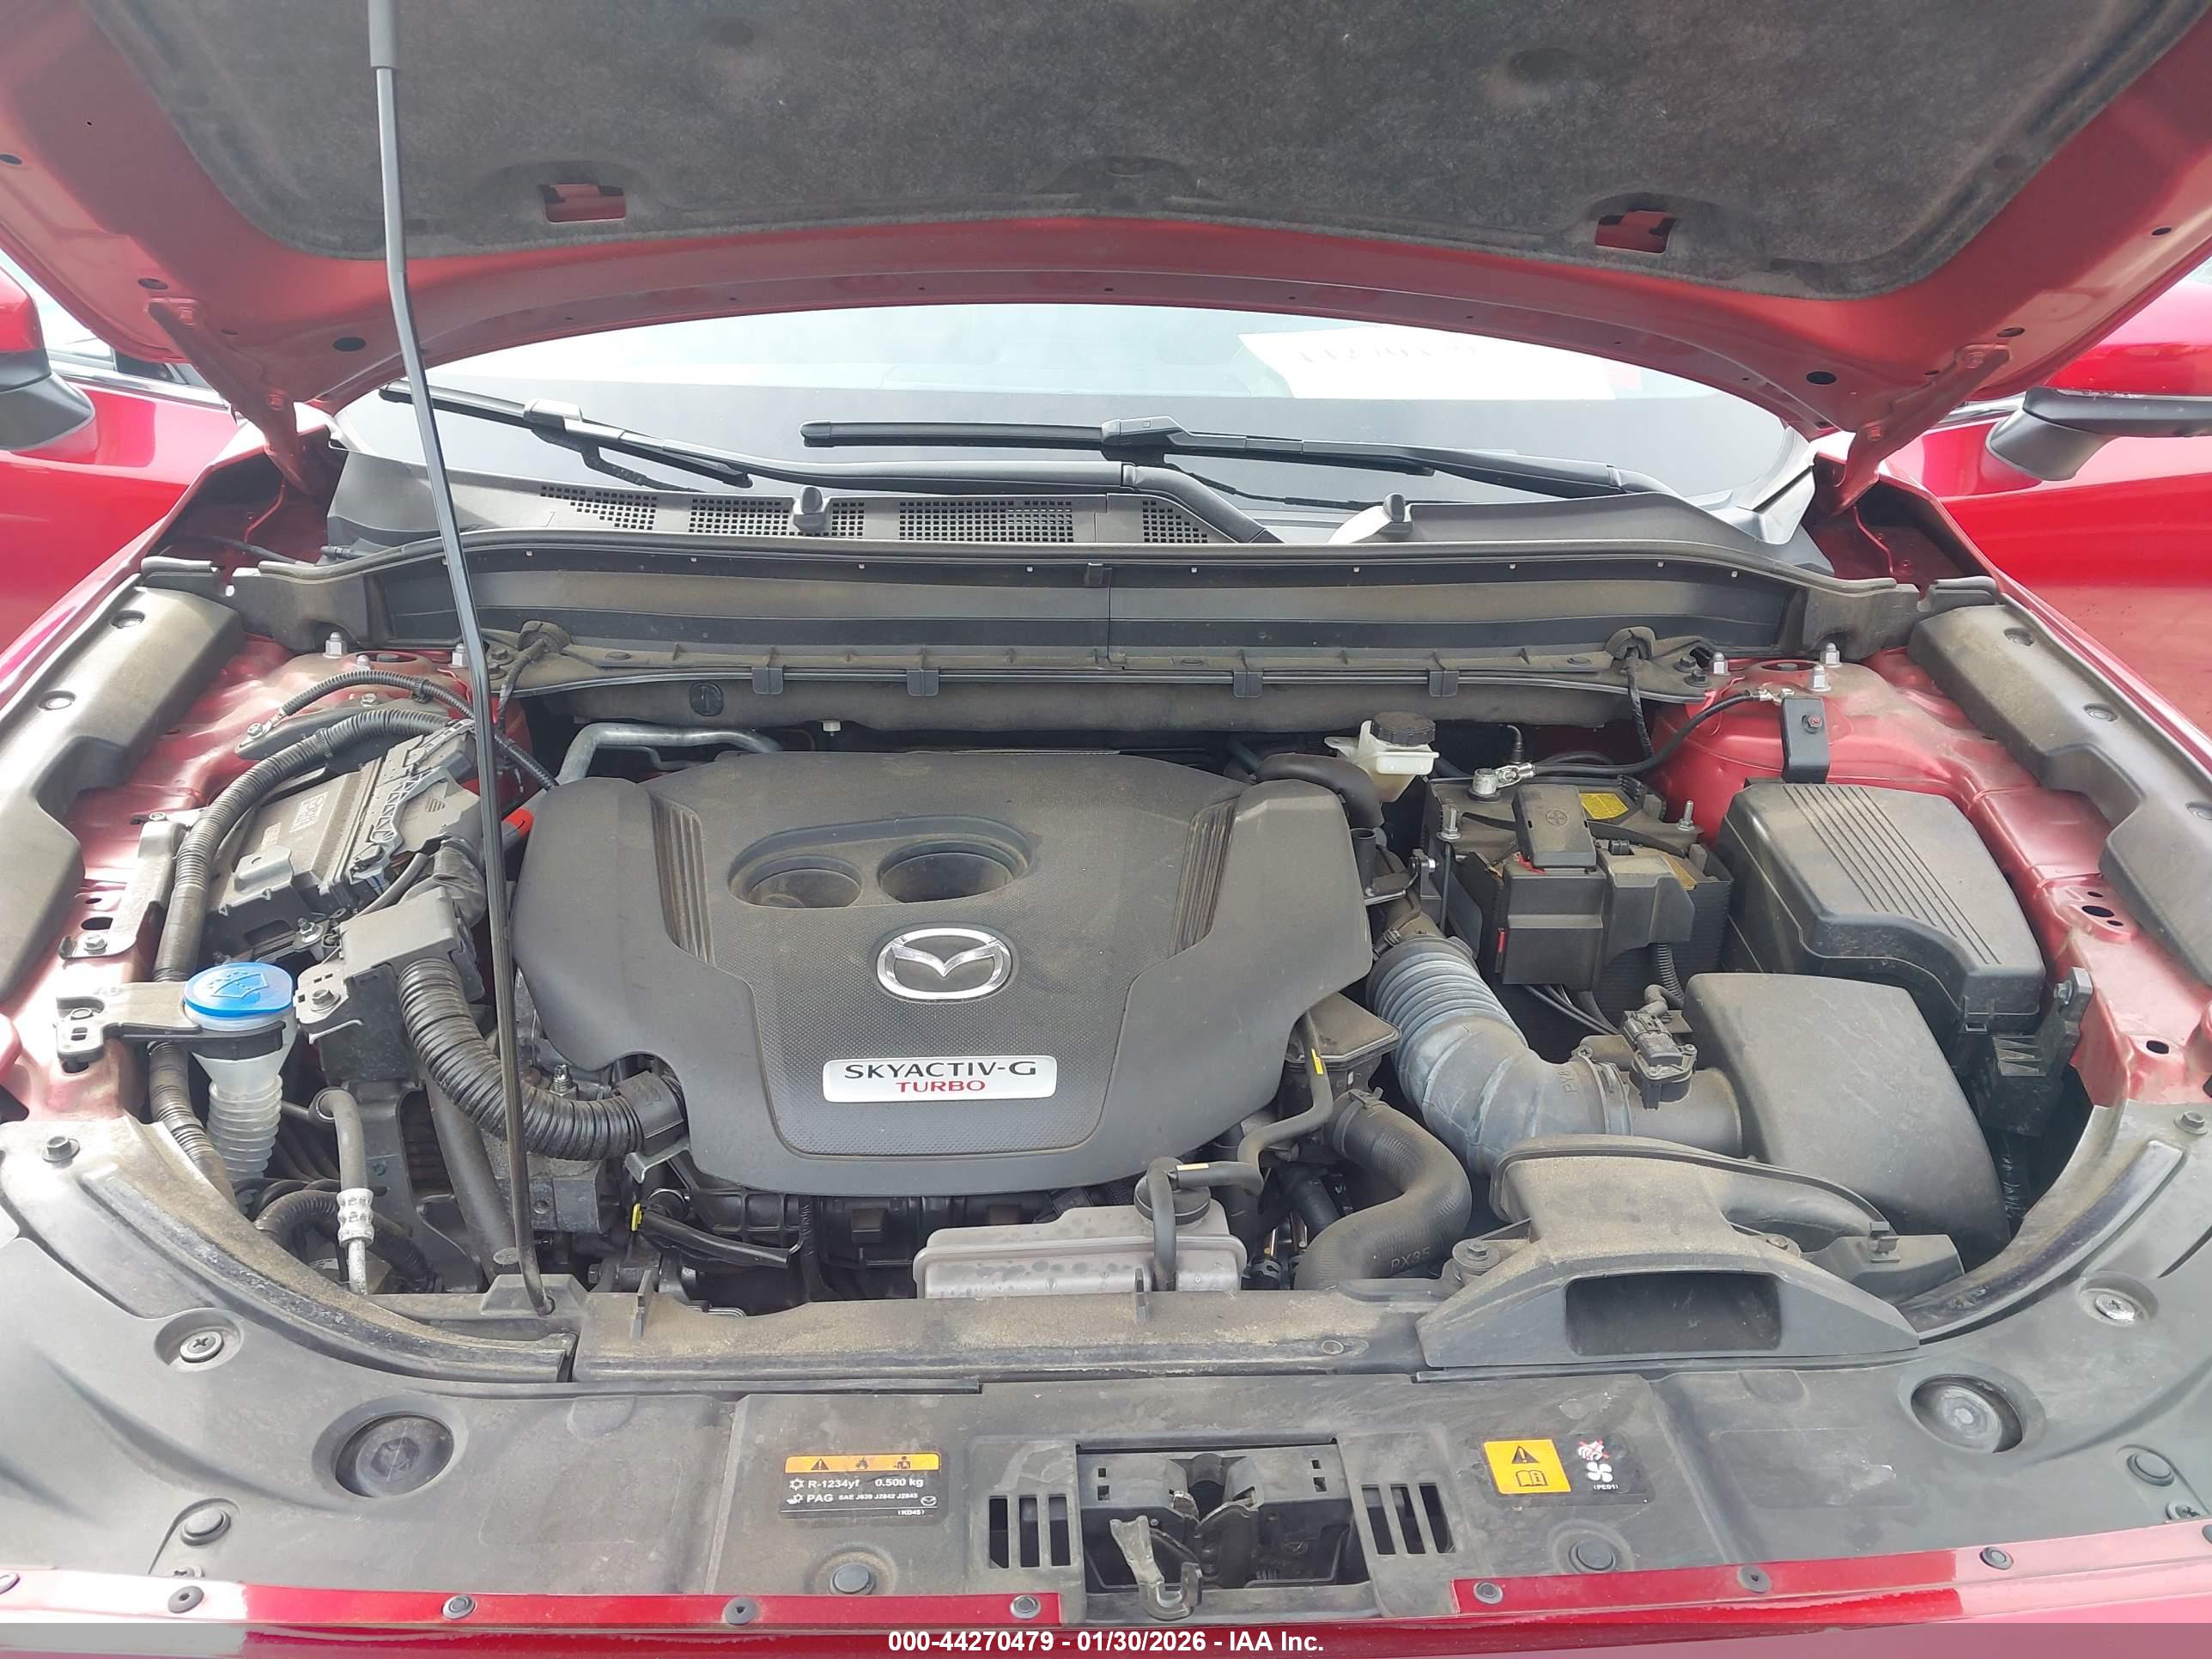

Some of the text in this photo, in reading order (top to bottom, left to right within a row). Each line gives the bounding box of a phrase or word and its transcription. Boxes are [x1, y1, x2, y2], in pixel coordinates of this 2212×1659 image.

[845, 1060, 1036, 1079] SKYACTIV-G
[896, 1079, 985, 1093] TURBO
[808, 1477, 924, 1490] R-1234yf 0.500 kg
[806, 1493, 834, 1503] PAG
